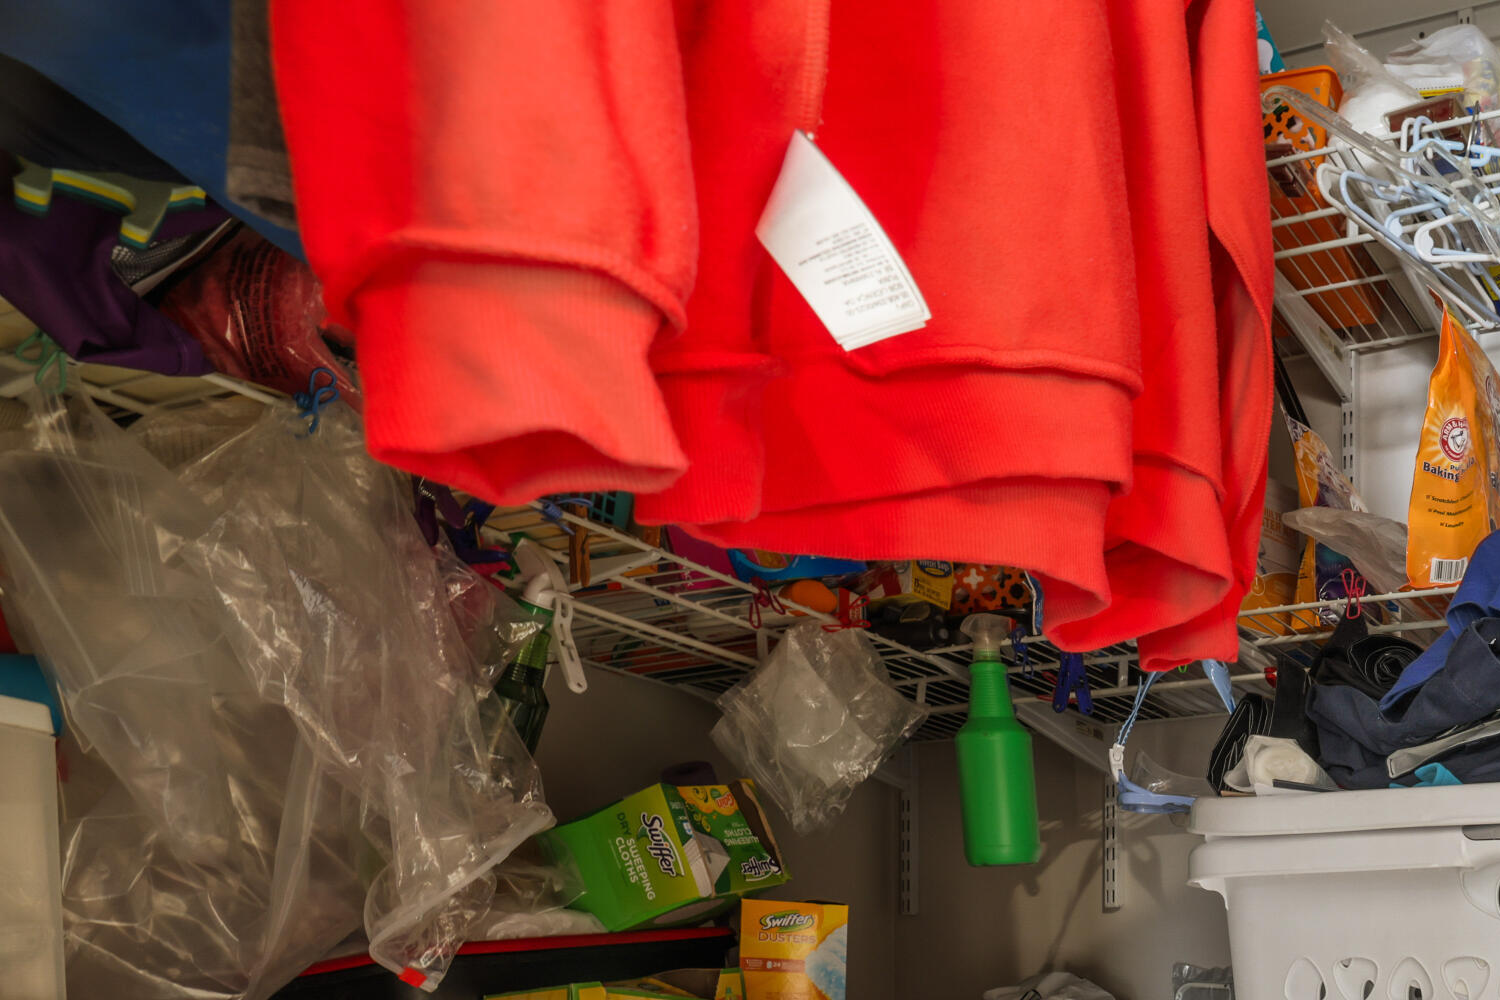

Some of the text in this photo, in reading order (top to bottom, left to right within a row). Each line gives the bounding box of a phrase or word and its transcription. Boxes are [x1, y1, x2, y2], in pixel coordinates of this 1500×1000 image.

[1423, 461, 1460, 483] Baking
[616, 811, 656, 901] DRY SWEEPING
[640, 812, 677, 878] Swiffer
[615, 836, 640, 885] CLOTHS
[741, 855, 782, 876] Swiffer
[761, 913, 812, 930] Swiffer
[758, 931, 817, 944] DUSTERS
